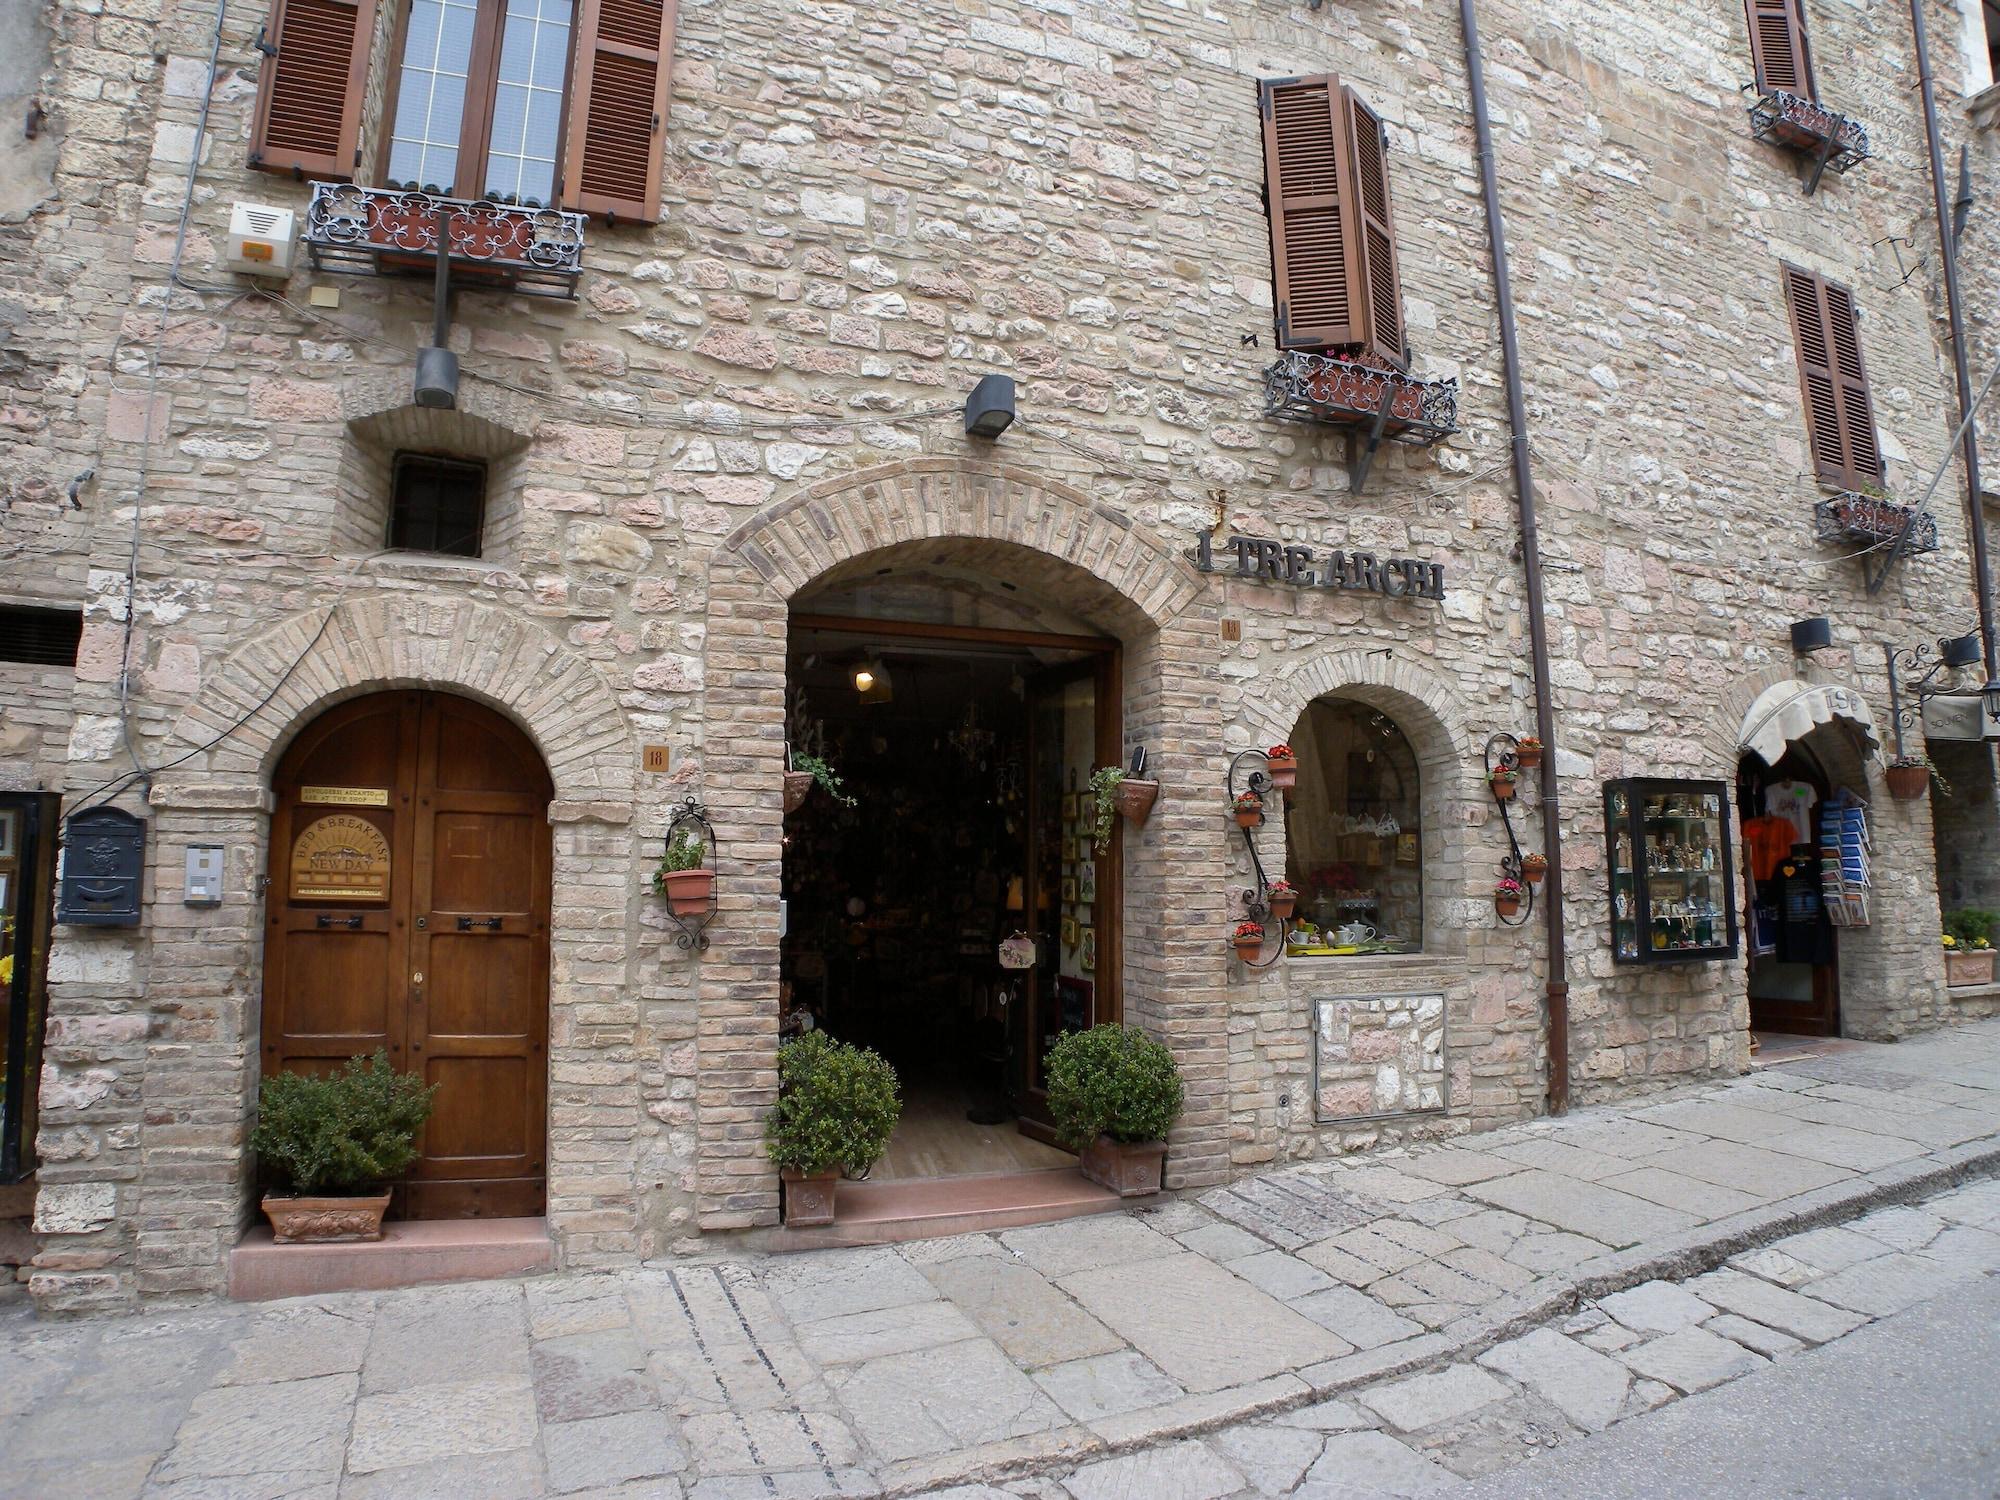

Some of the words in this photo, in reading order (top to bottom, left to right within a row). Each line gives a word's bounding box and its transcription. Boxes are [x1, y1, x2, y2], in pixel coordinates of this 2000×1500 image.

[1197, 531, 1214, 572] I
[1225, 536, 1315, 585] TRE
[1318, 550, 1446, 600] ARCHI
[650, 751, 662, 766] 18
[296, 831, 316, 859] BED
[327, 817, 388, 863] BREAKFAST
[310, 859, 339, 870] NEW
[345, 860, 374, 871] DAY
